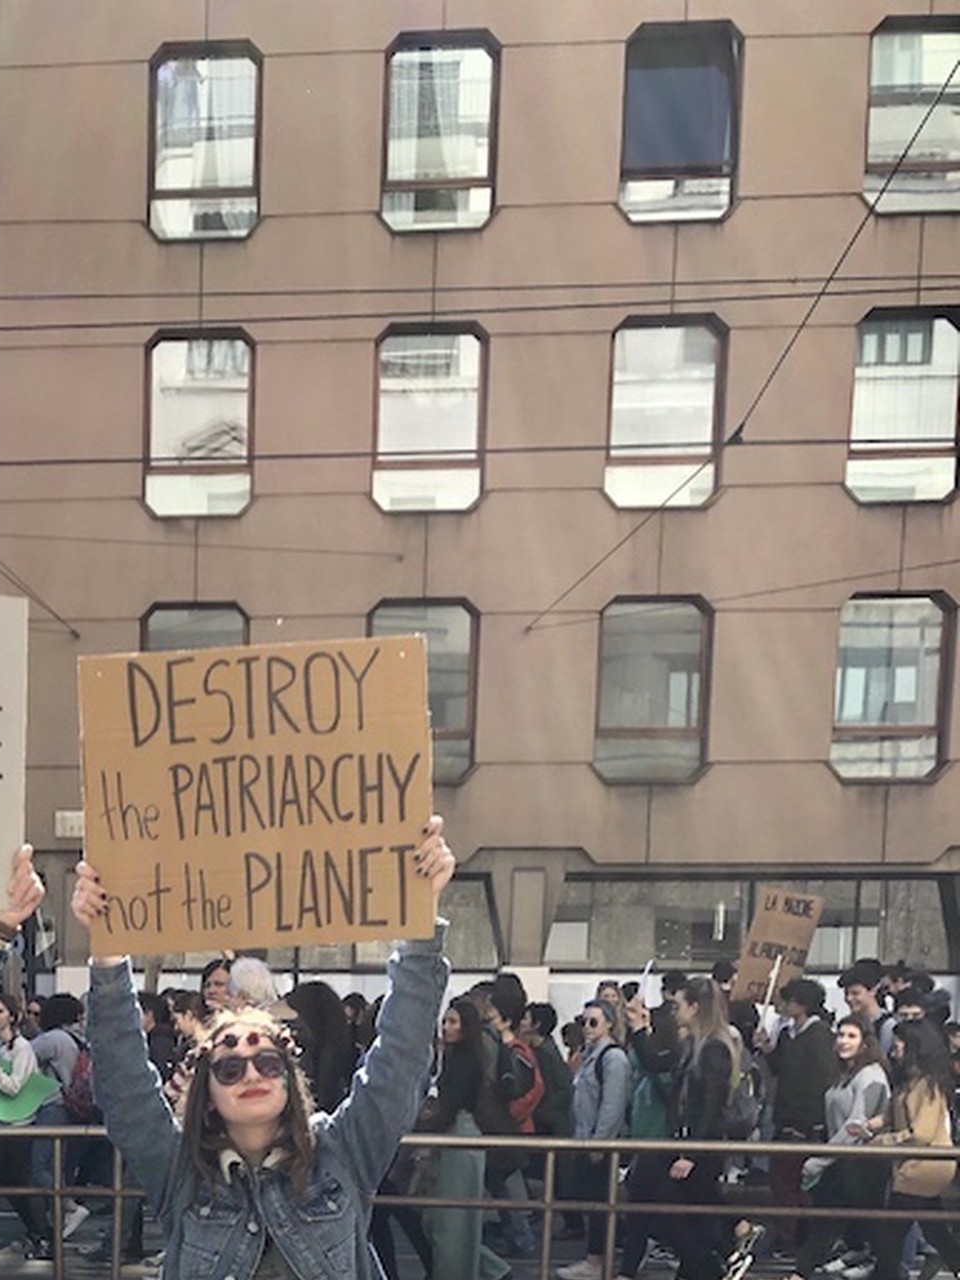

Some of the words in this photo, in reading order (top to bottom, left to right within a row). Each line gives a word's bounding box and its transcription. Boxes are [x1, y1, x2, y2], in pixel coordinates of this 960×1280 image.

[127, 647, 380, 748] DESTROY
[100, 770, 160, 841] the
[168, 753, 421, 840] PATRIARCHY
[104, 862, 171, 934] not
[182, 862, 233, 931] the
[243, 844, 416, 932] PLANET
